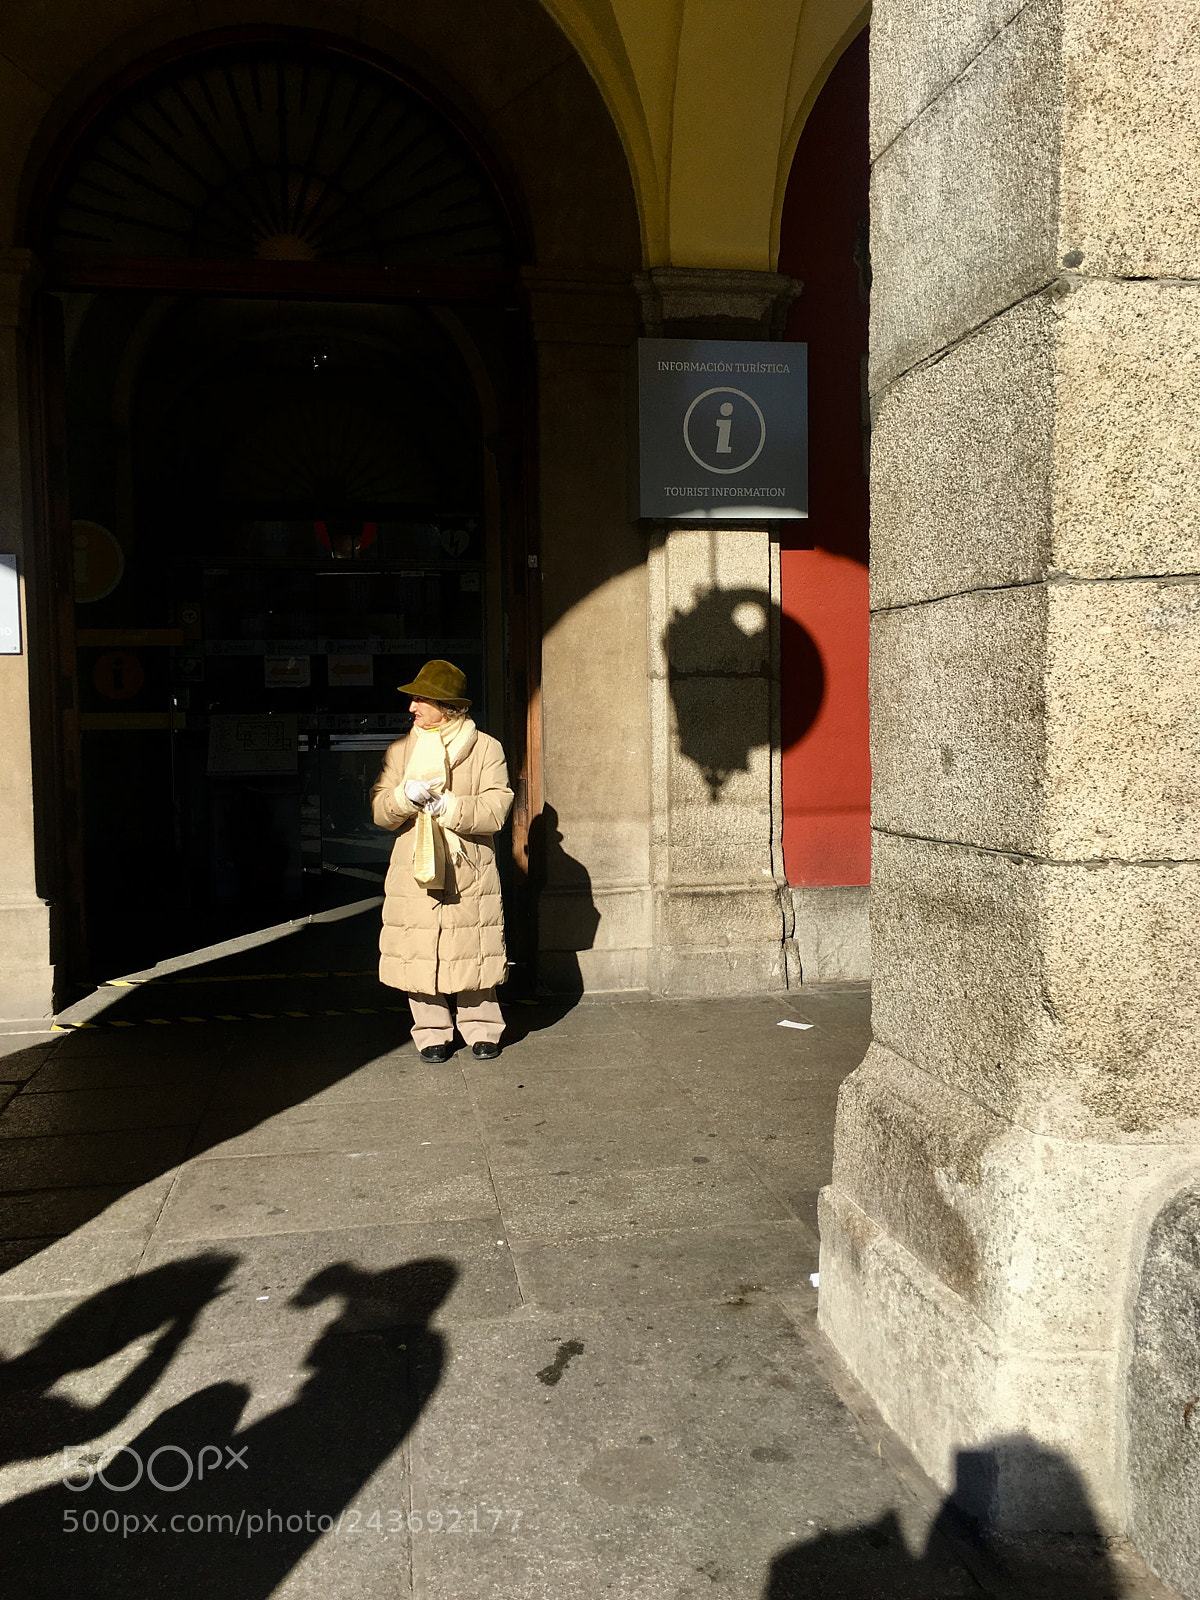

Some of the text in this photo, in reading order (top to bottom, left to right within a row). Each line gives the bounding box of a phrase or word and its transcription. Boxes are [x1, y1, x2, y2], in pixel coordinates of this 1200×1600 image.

[657, 361, 790, 373] INFORMACIÓN TURÍSTICA
[664, 487, 786, 497] TOURIST INFORMATION
